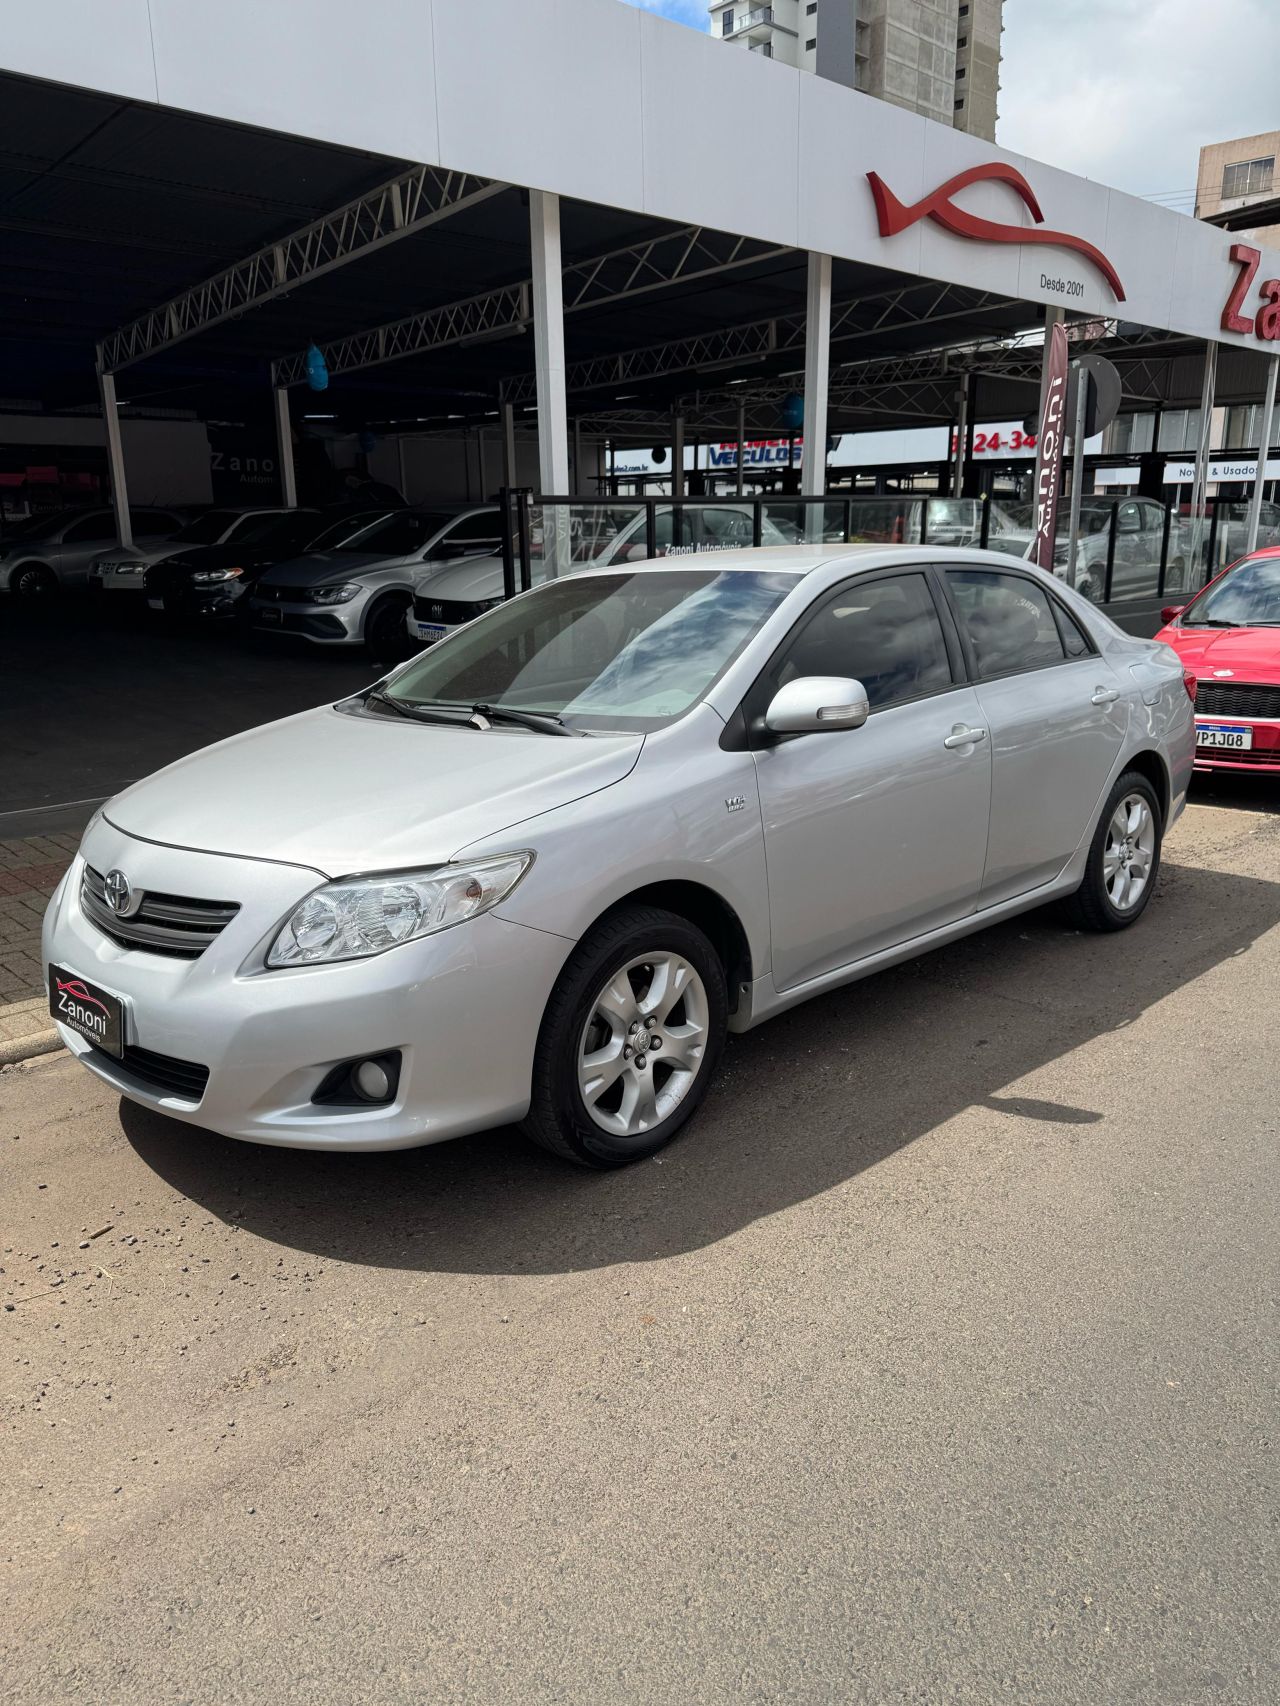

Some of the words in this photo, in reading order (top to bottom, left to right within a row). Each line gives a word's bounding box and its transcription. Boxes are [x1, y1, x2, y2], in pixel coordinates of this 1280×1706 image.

[1040, 274, 1065, 293] Desde
[1066, 280, 1084, 297] 2001
[1211, 467, 1219, 476] &
[665, 543, 694, 556] Zanoni
[58, 991, 106, 1035] Zanoni
[67, 1016, 101, 1043] Automóveis
